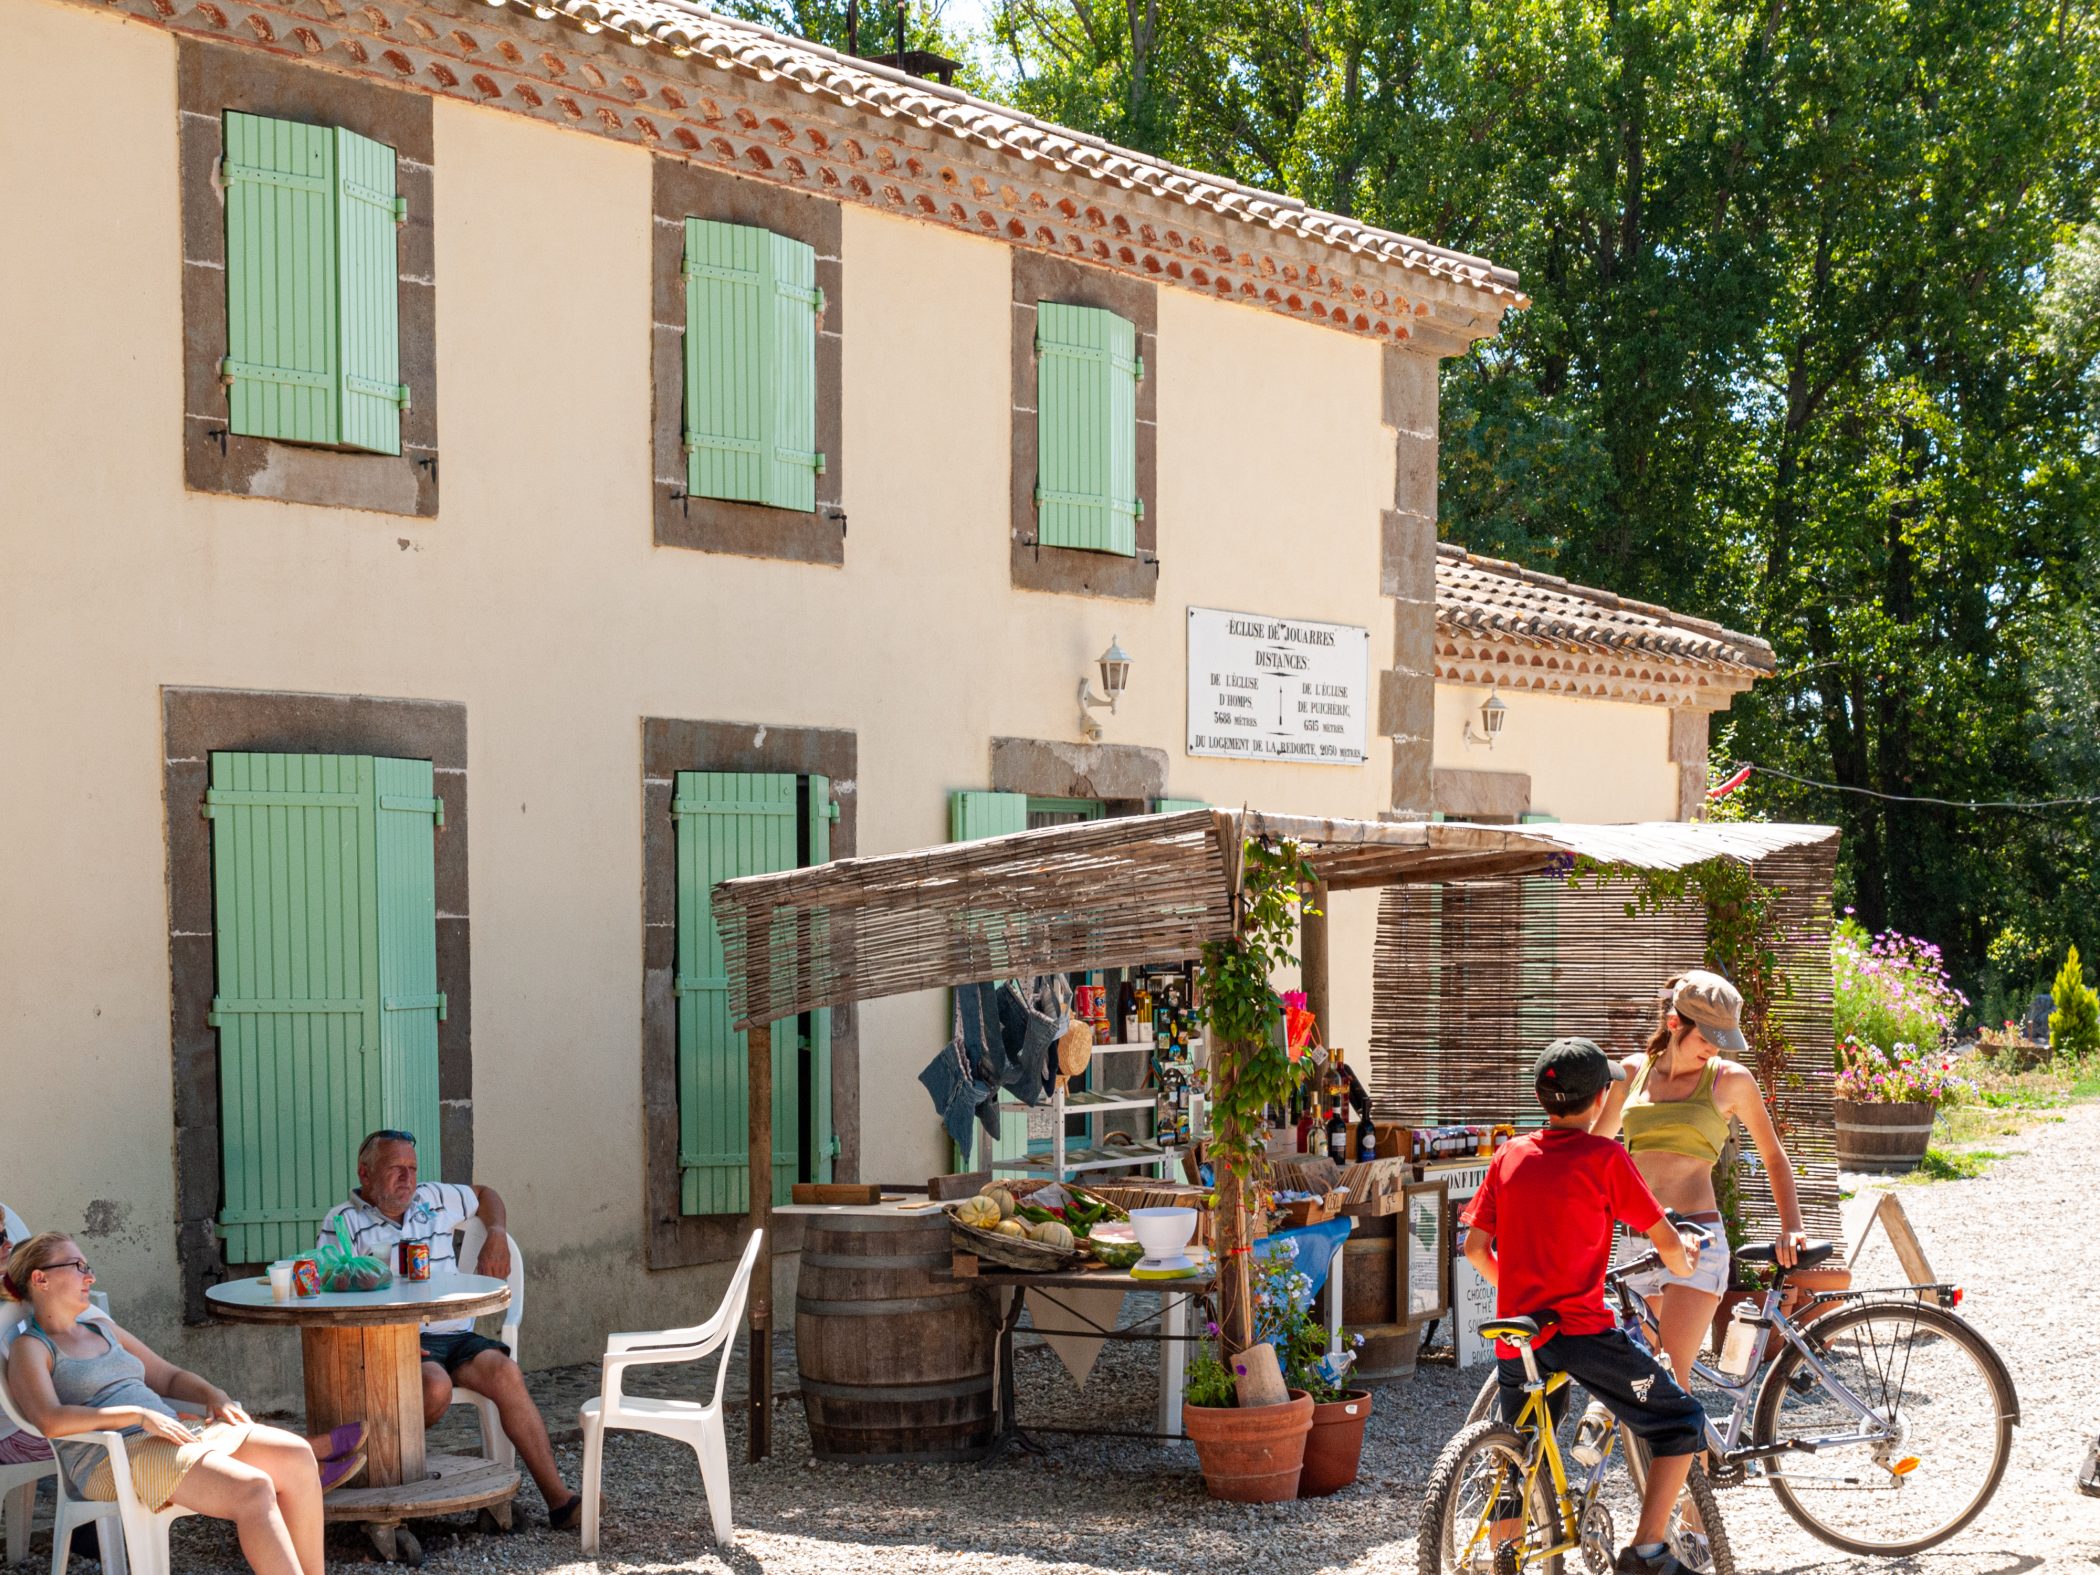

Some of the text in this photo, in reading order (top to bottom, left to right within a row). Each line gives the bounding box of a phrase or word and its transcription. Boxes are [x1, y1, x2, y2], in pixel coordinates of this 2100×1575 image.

[1267, 623, 1280, 641] DE
[1210, 672, 1221, 686] DE
[1302, 682, 1312, 696] DE
[1297, 701, 1309, 714] DE
[1303, 719, 1319, 732] 6515
[1195, 734, 1206, 748] DU
[1208, 736, 1249, 751] LOGEMENT
[1253, 740, 1263, 752] DE
[1266, 741, 1277, 753] LA
